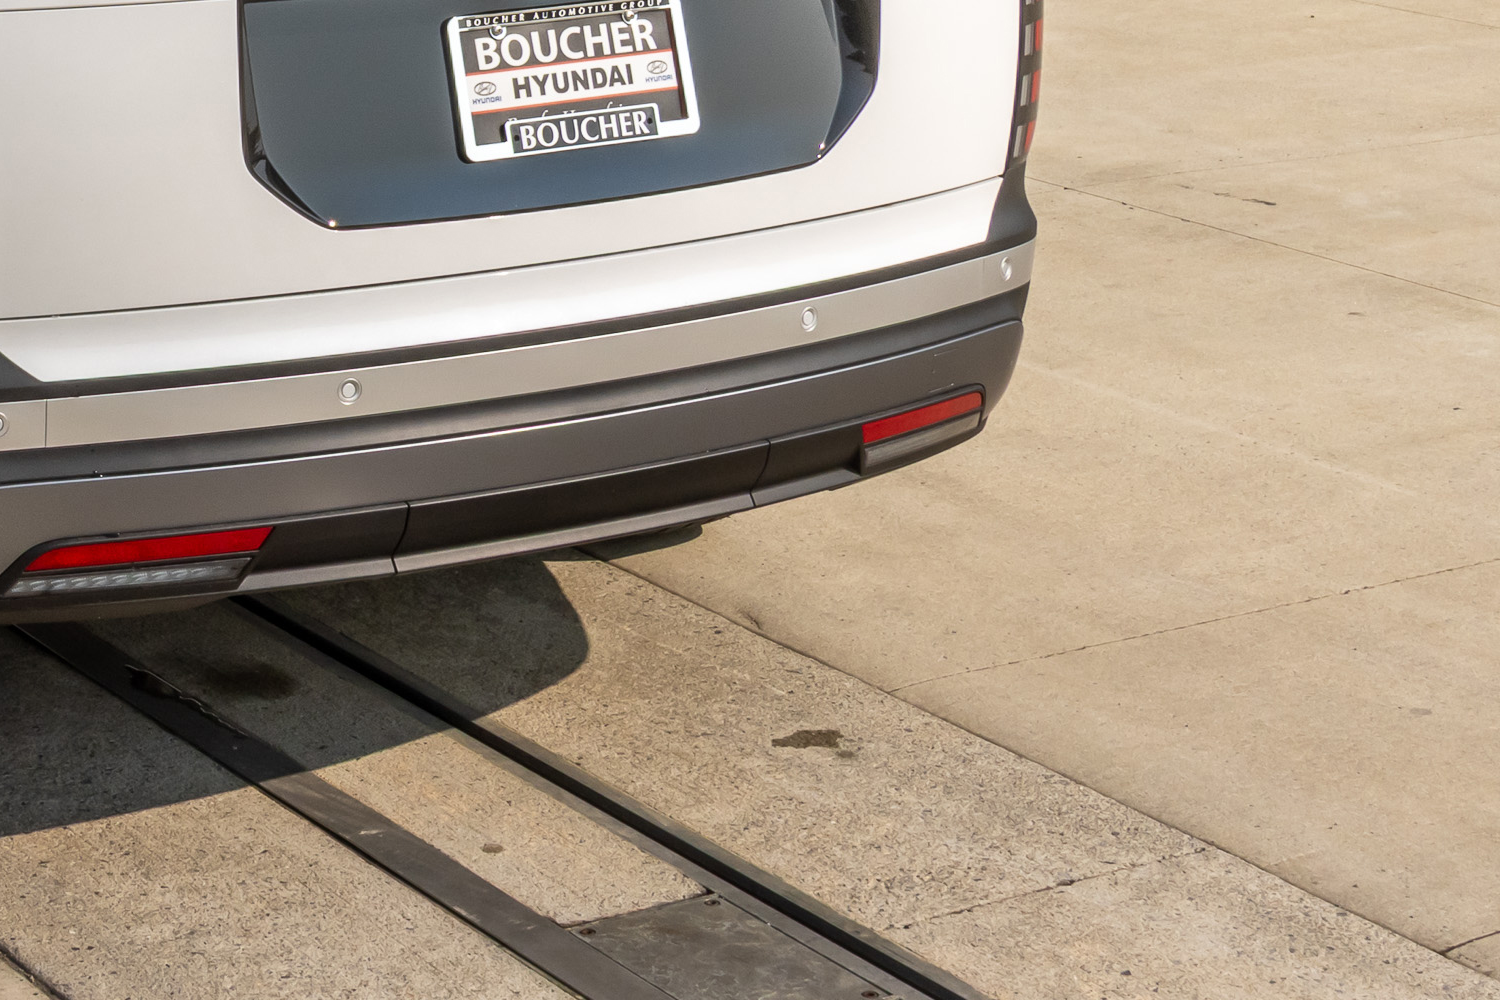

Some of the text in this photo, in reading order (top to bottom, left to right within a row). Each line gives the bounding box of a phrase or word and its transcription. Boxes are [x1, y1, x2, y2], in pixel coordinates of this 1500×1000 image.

[466, 13, 525, 27] BOUCHER
[533, 4, 614, 19] AUTOMOTIVE
[475, 18, 657, 71] BOUCHER
[512, 63, 634, 99] HYUNDAI
[644, 74, 673, 83] HYUNDAI
[472, 96, 502, 105] HYUNDAI
[520, 110, 649, 150] BOUCHER
